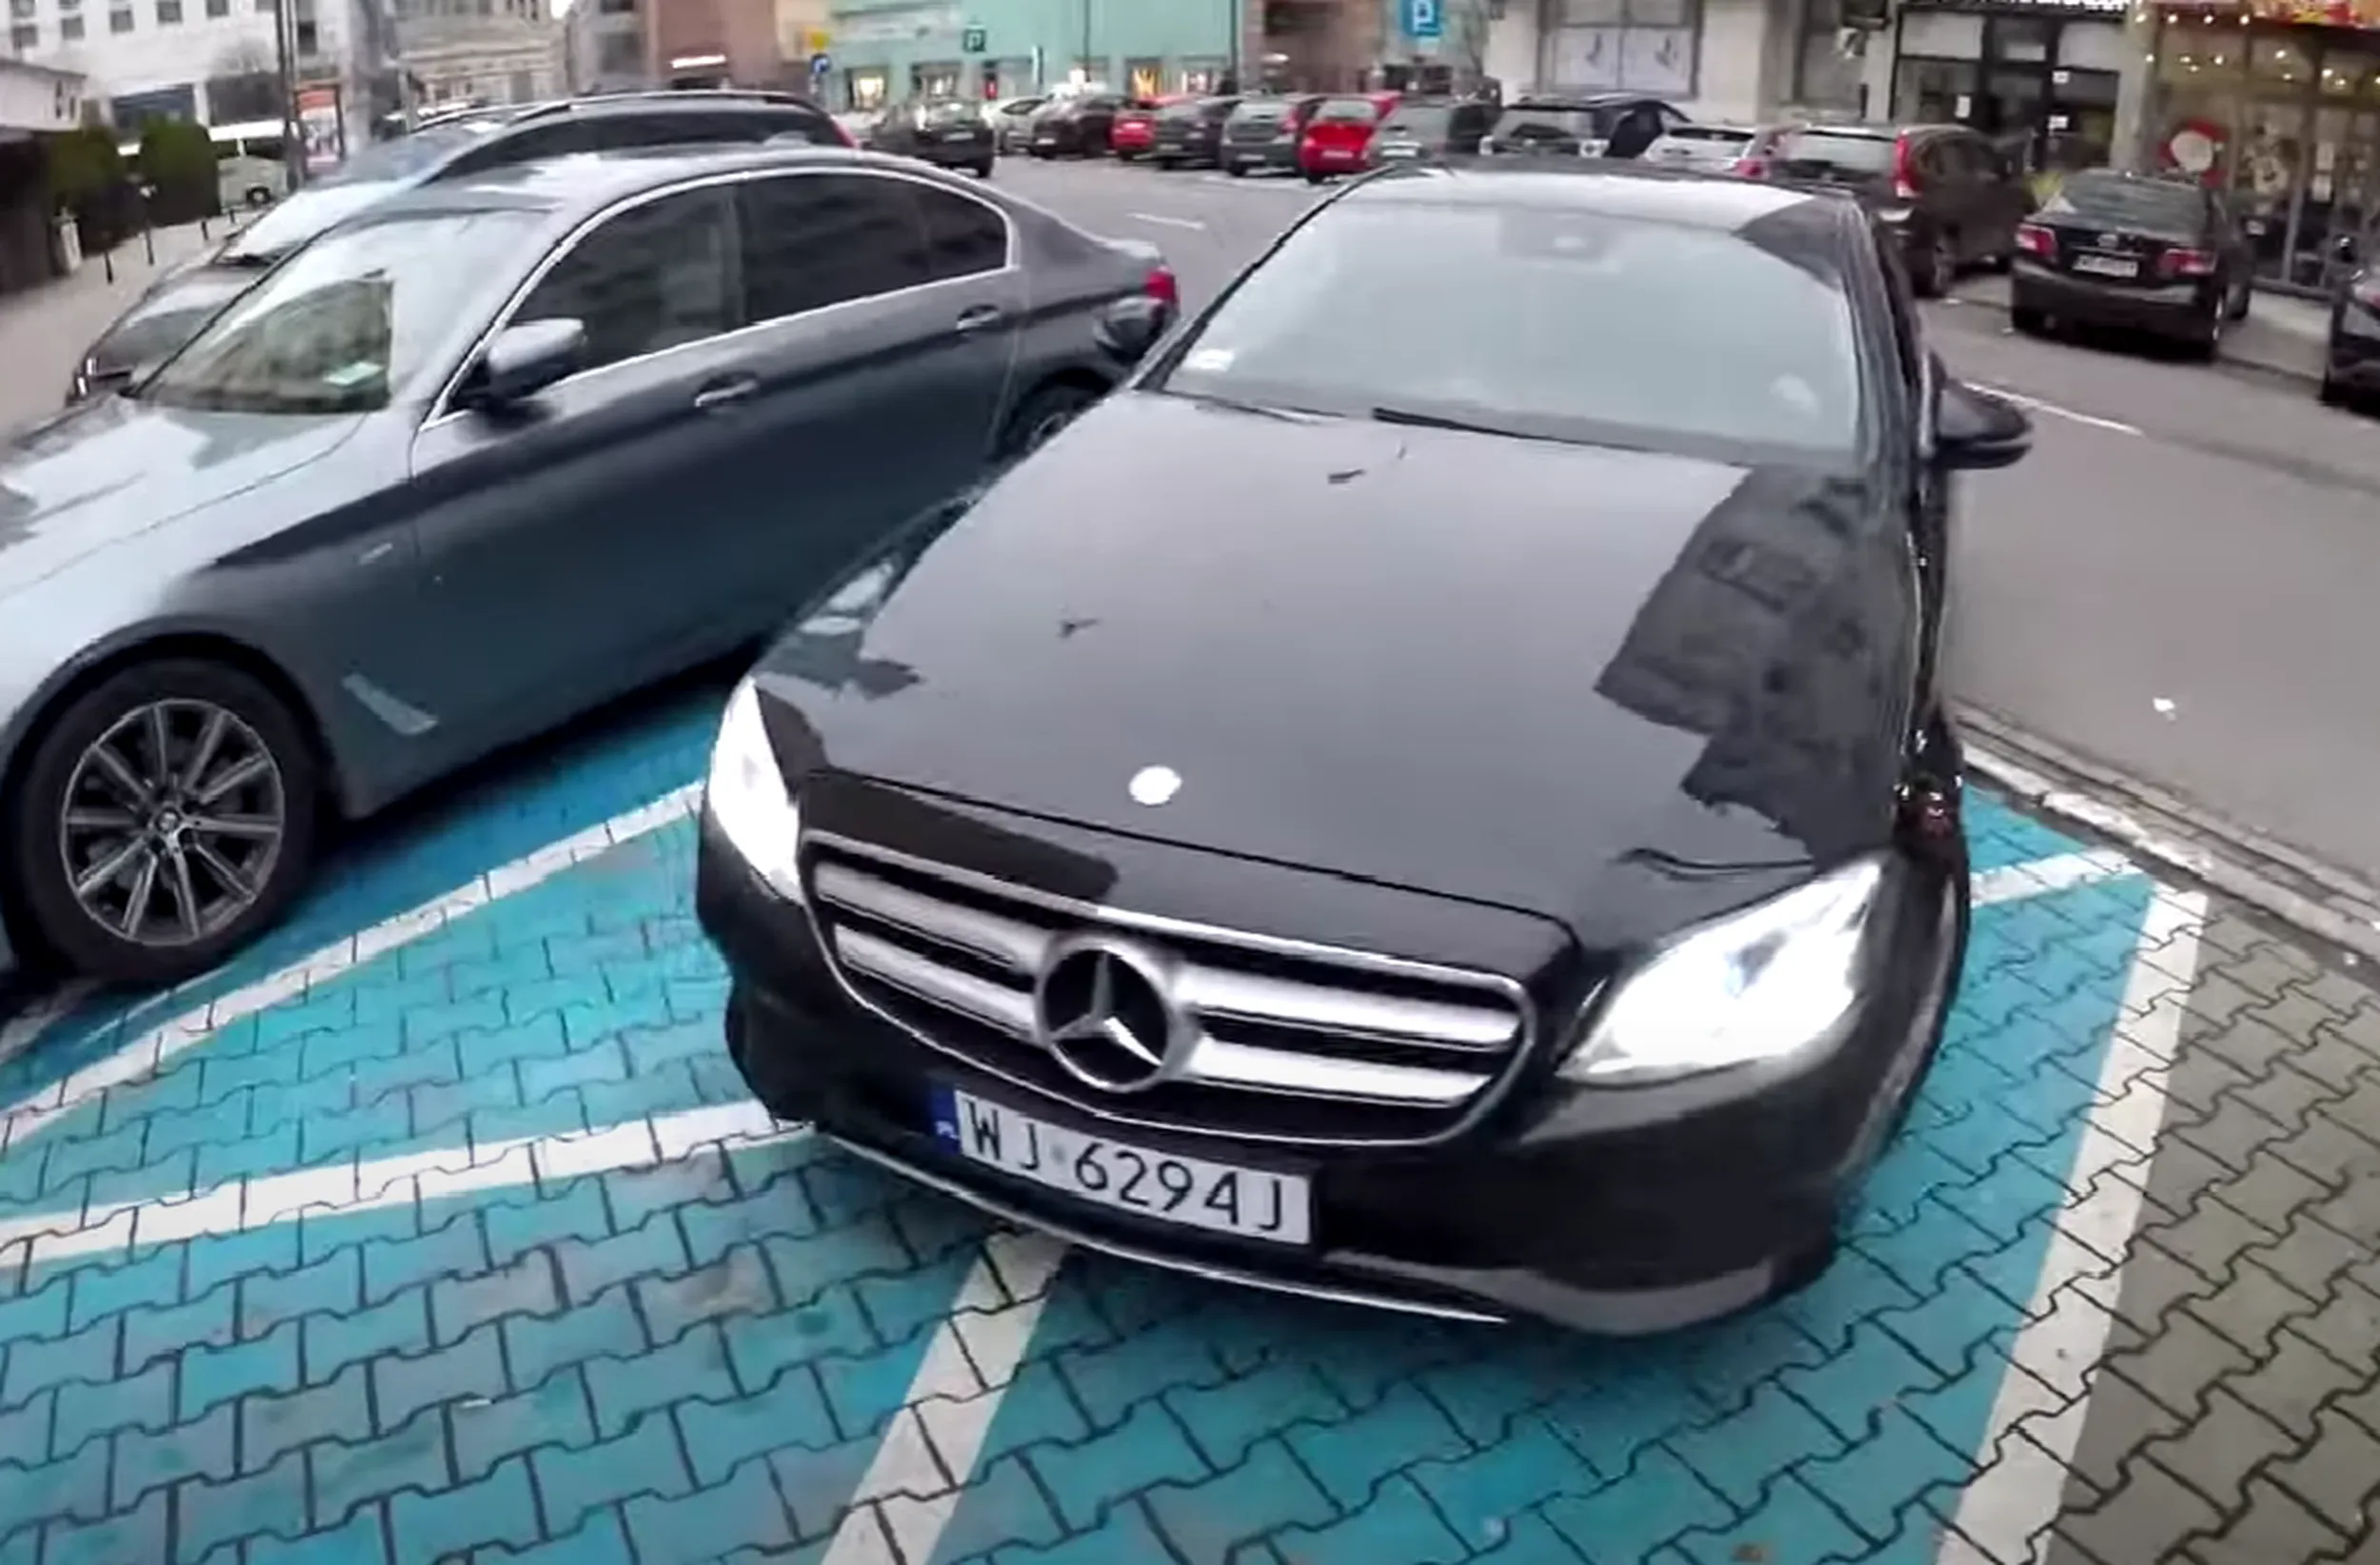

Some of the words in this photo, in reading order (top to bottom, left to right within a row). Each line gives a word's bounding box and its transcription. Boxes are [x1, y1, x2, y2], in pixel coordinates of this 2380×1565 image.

[1412, 0, 1433, 32] P
[966, 1100, 1041, 1170] WJ
[1073, 1141, 1283, 1232] 6294J
